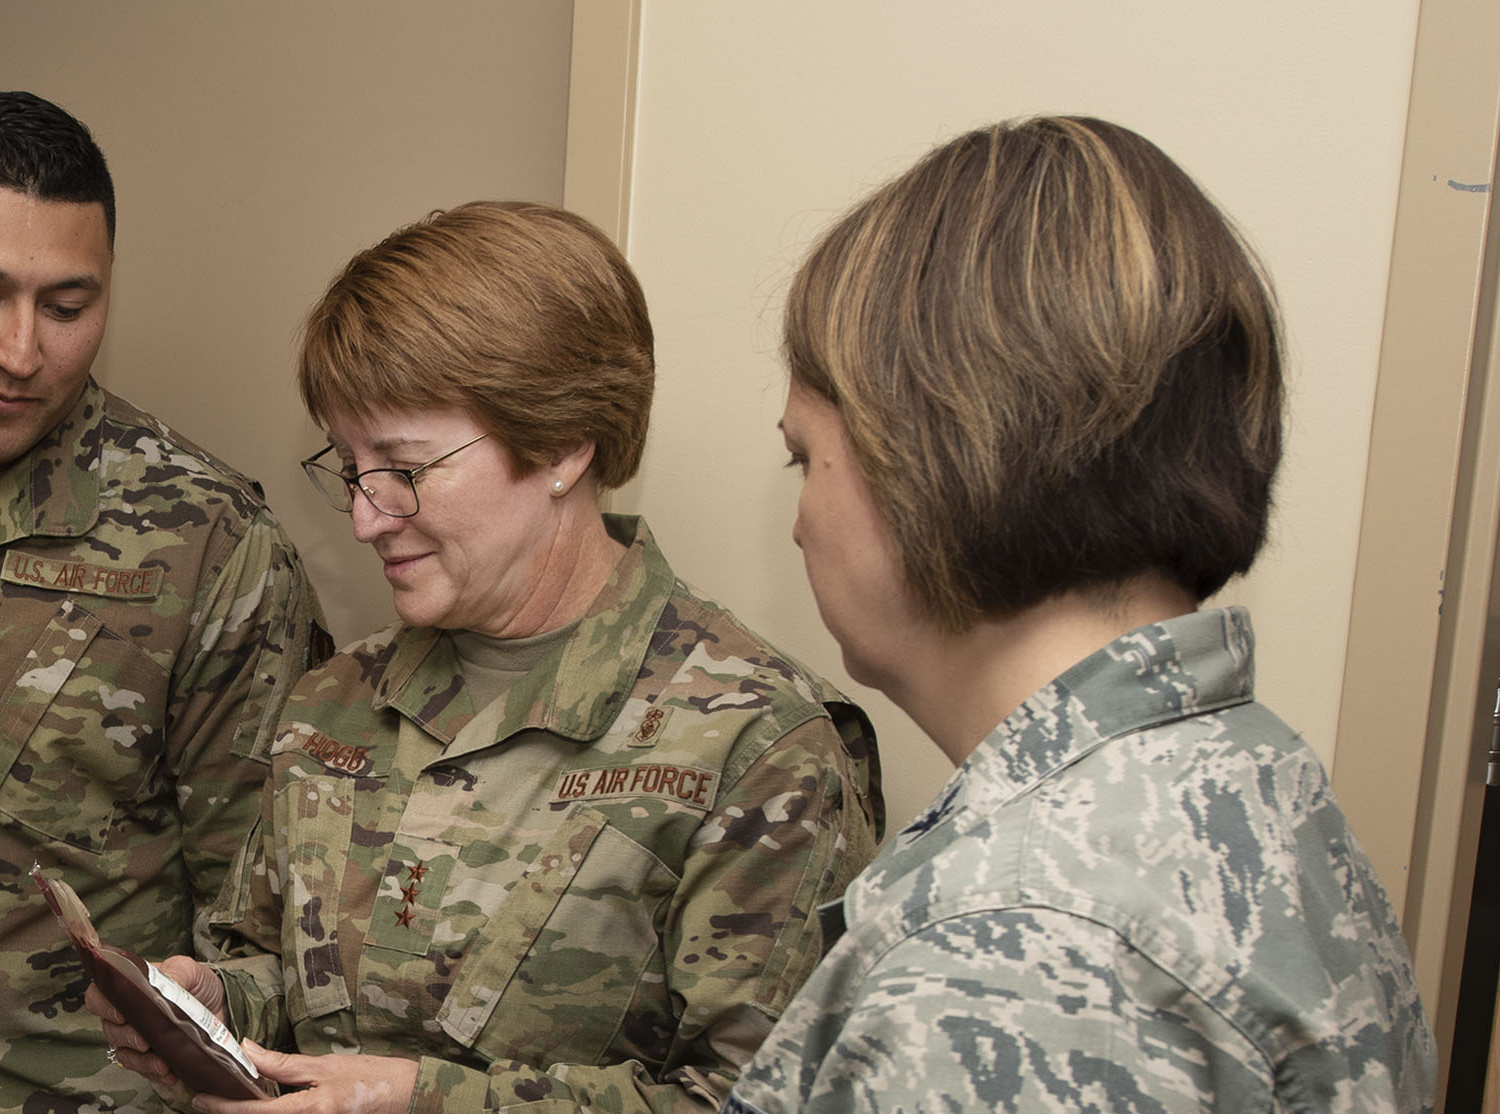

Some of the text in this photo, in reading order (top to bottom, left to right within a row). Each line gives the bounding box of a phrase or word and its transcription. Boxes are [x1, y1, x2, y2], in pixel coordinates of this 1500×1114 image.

[13, 555, 153, 594] U.S. AIR FORCE
[301, 731, 365, 771] HOGG
[591, 767, 630, 795] AIR
[629, 765, 713, 805] FORCE
